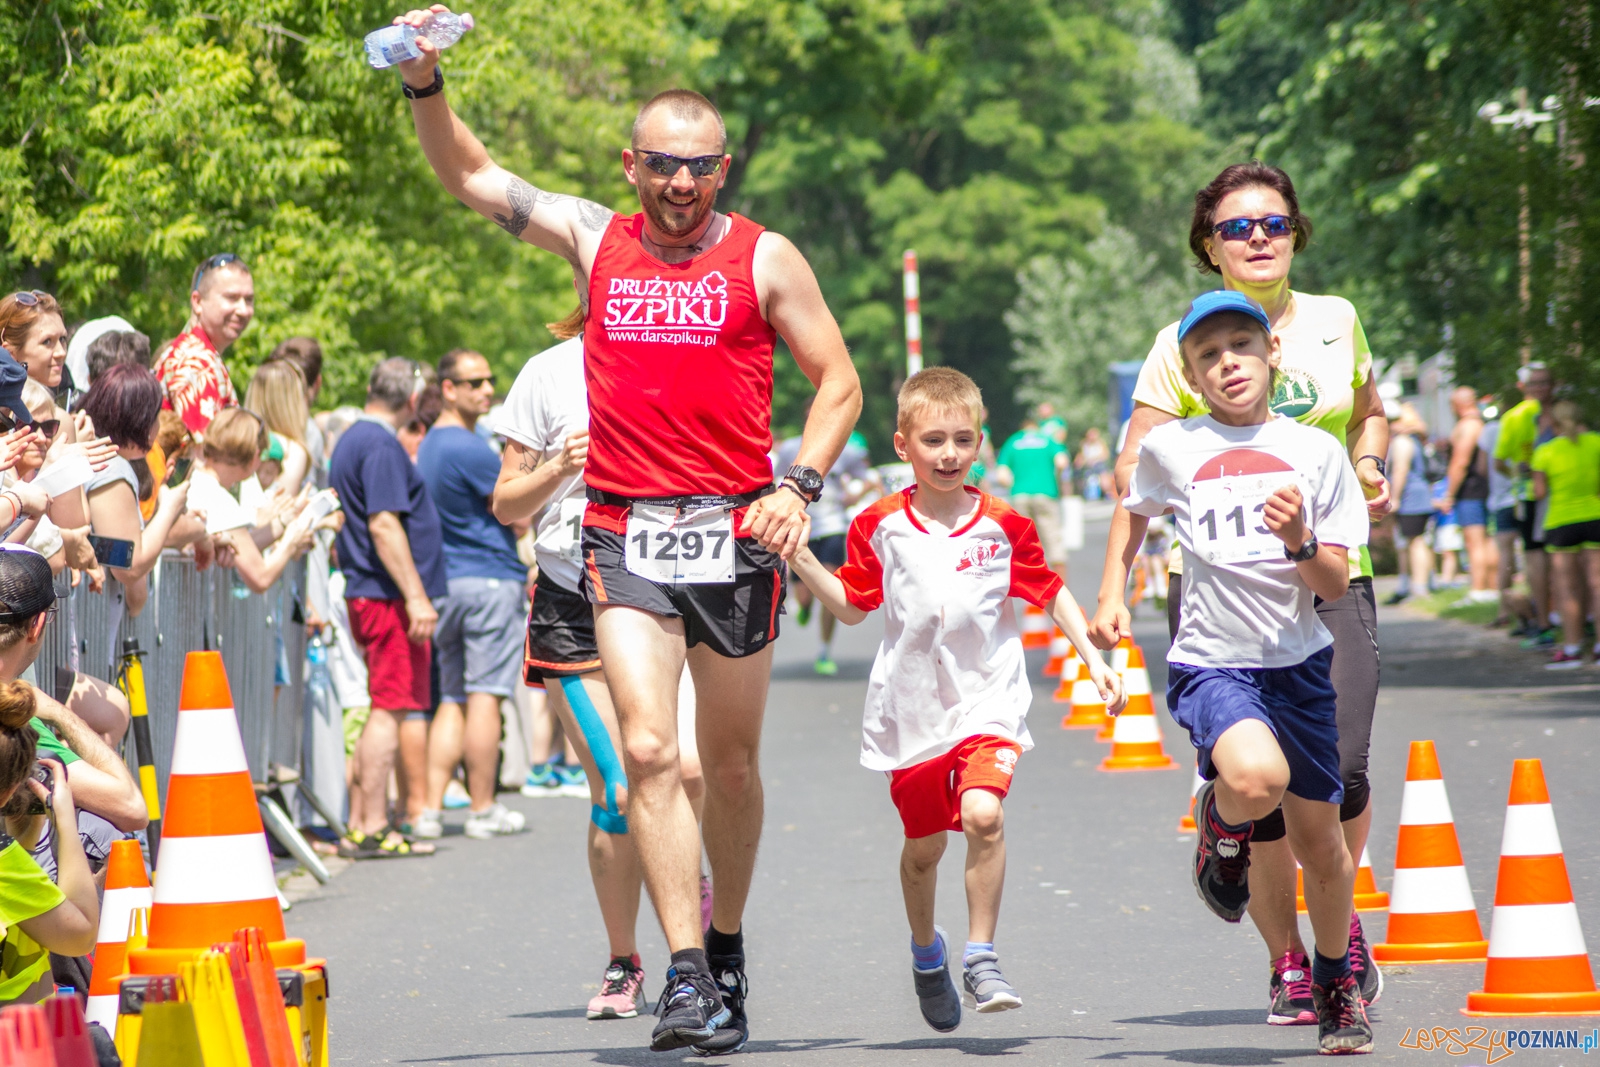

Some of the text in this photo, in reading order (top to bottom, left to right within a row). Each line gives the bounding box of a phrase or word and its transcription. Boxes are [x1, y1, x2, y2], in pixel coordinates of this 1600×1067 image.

[608, 275, 707, 297] DRUŻYNA
[604, 297, 729, 326] SZPIKU
[608, 330, 717, 347] www.darszpiku.pl
[632, 529, 730, 560] 1297
